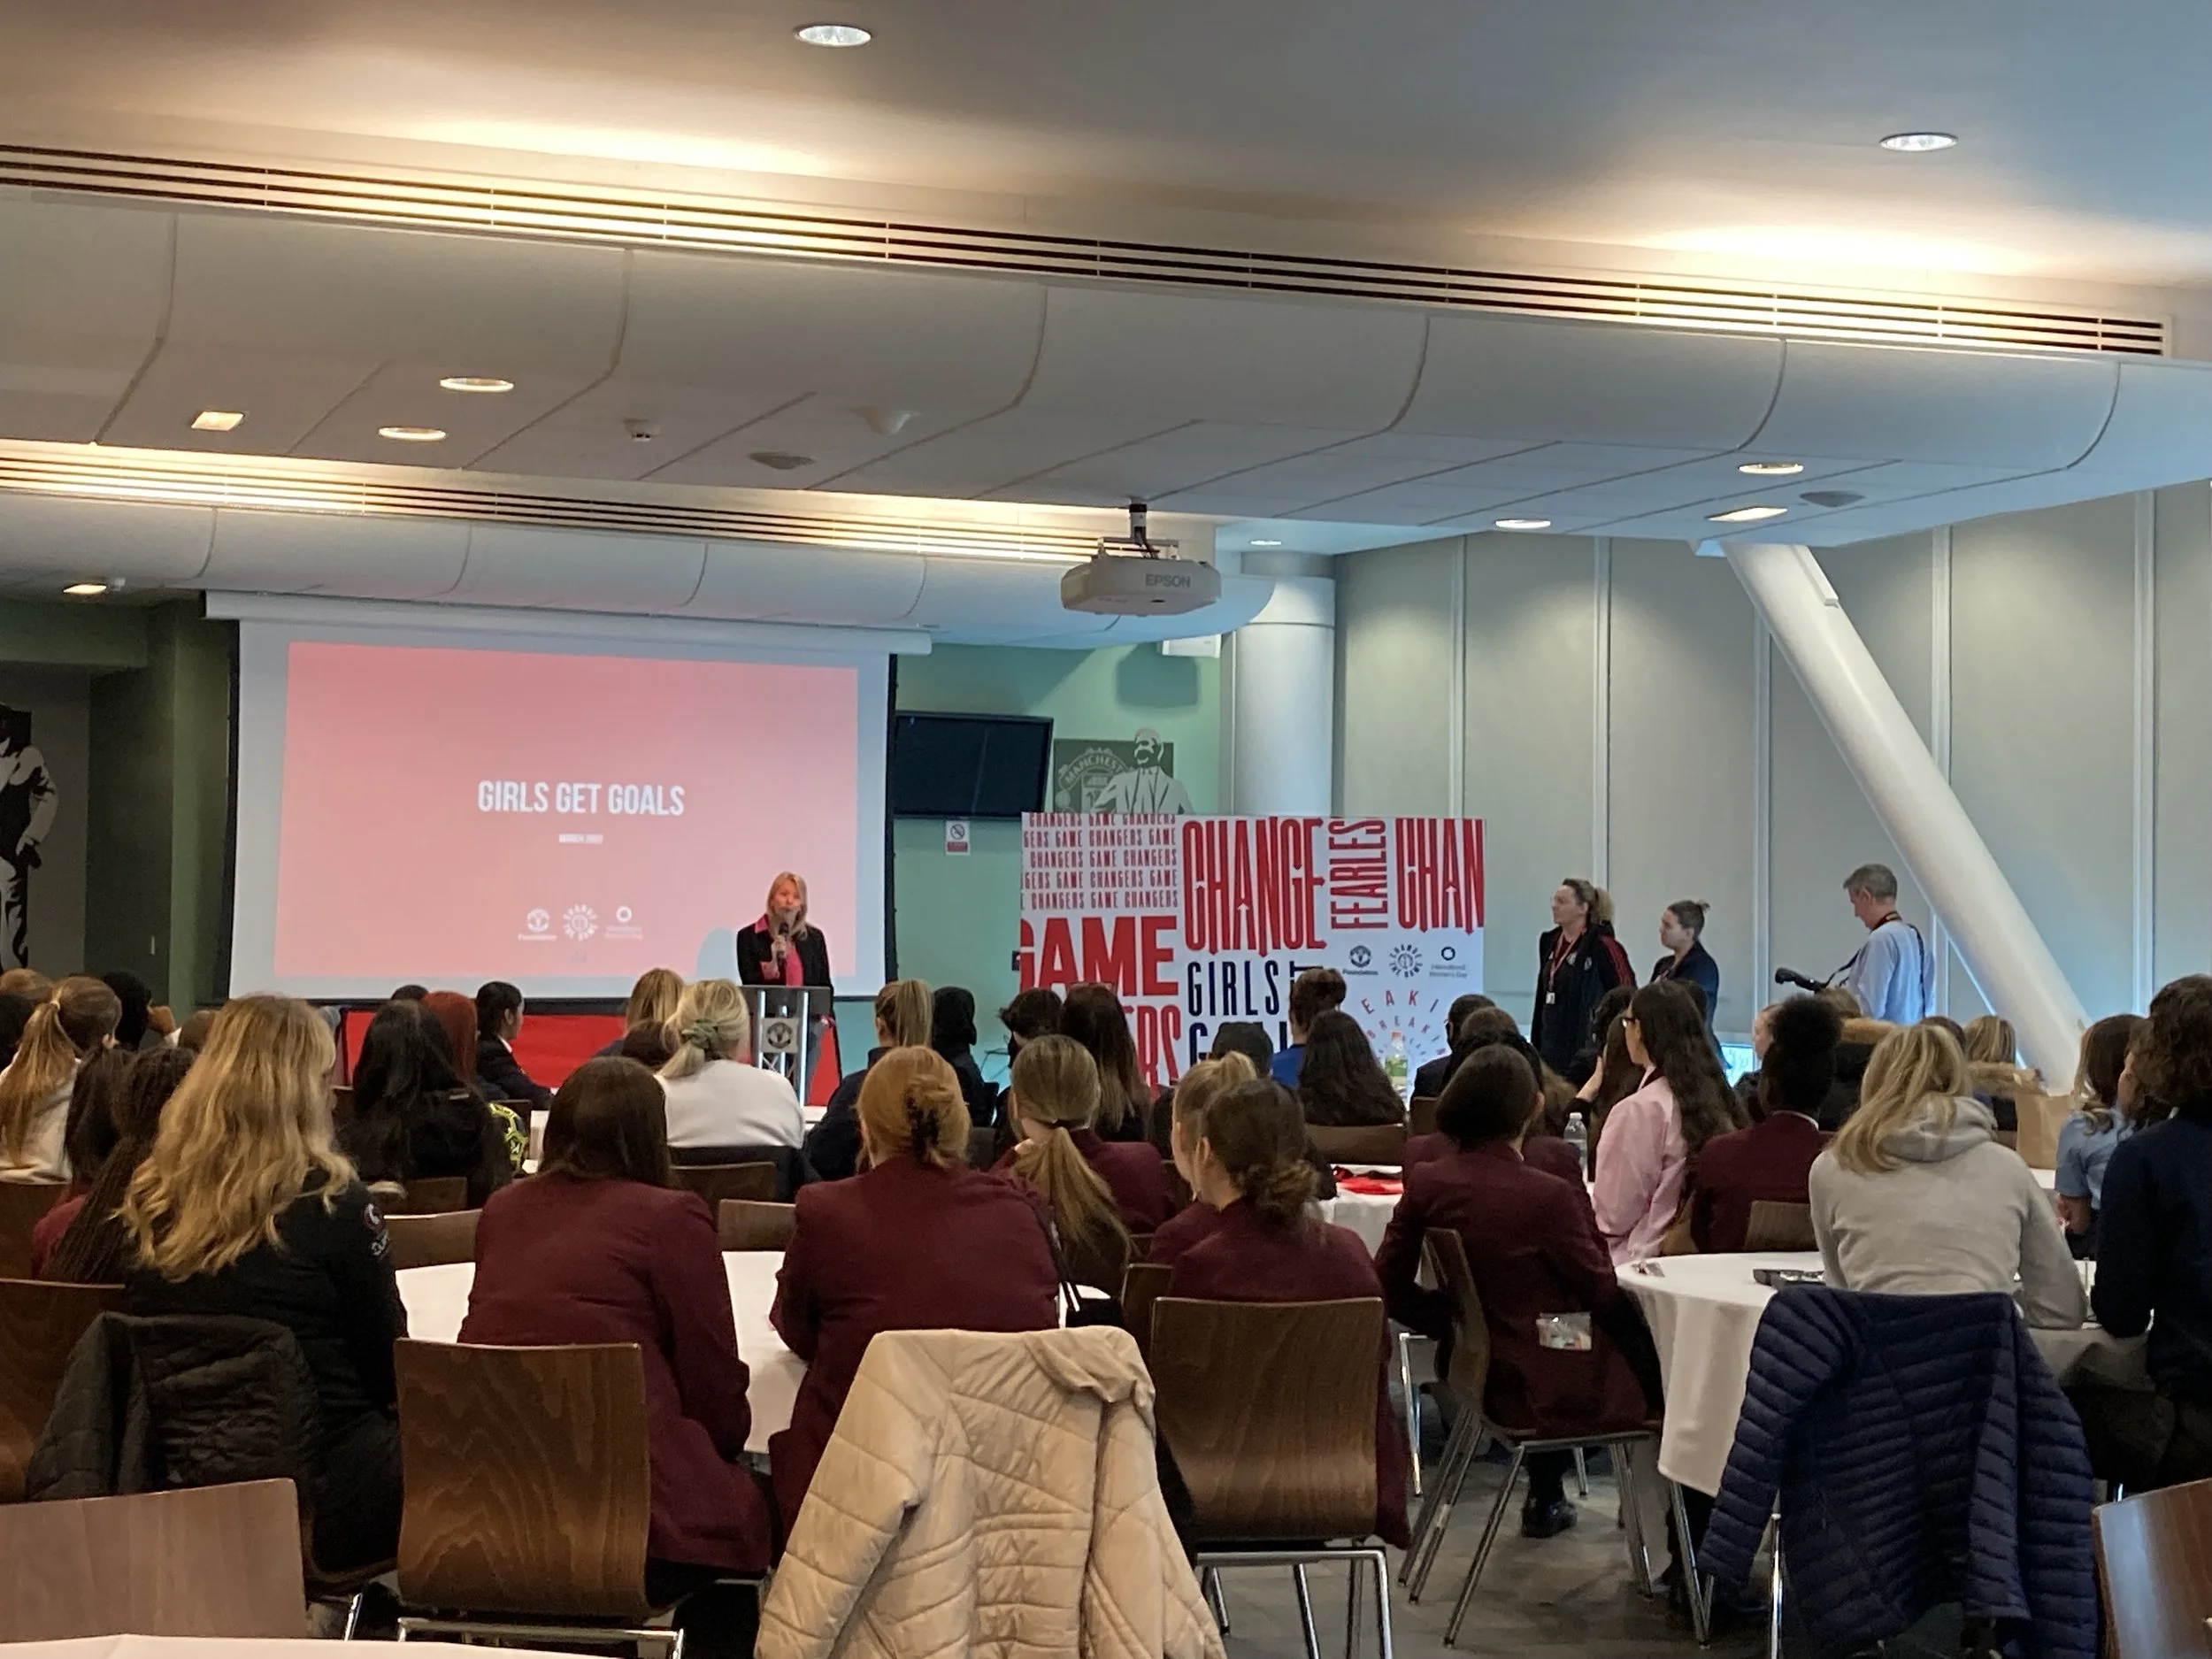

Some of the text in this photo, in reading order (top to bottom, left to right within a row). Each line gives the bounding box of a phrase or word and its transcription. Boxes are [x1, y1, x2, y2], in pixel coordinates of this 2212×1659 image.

[1146, 573, 1191, 588] EPSON
[1065, 755, 1123, 784] MANCHEST
[478, 780, 685, 816] GIRLS GET GOALS
[1029, 812, 1176, 827] CHANGERS GAME CHANGERS
[1056, 830, 1082, 848] GAME
[1089, 828, 1142, 847] CHANGERS
[1149, 827, 1176, 846] GAME
[1030, 849, 1177, 868] CHANGERS GAME CHANGERS
[1020, 869, 1177, 889] GERS GAME CHANGERS GAME
[1328, 817, 1388, 929] FEARLES
[1395, 818, 1484, 935] CHAN
[1182, 816, 1328, 957] CHANGE
[1032, 891, 1085, 910] CHANGERS
[1091, 890, 1118, 909] GAME
[1125, 889, 1179, 908] CHANGERS
[1187, 960, 1279, 1017] GIRLS
